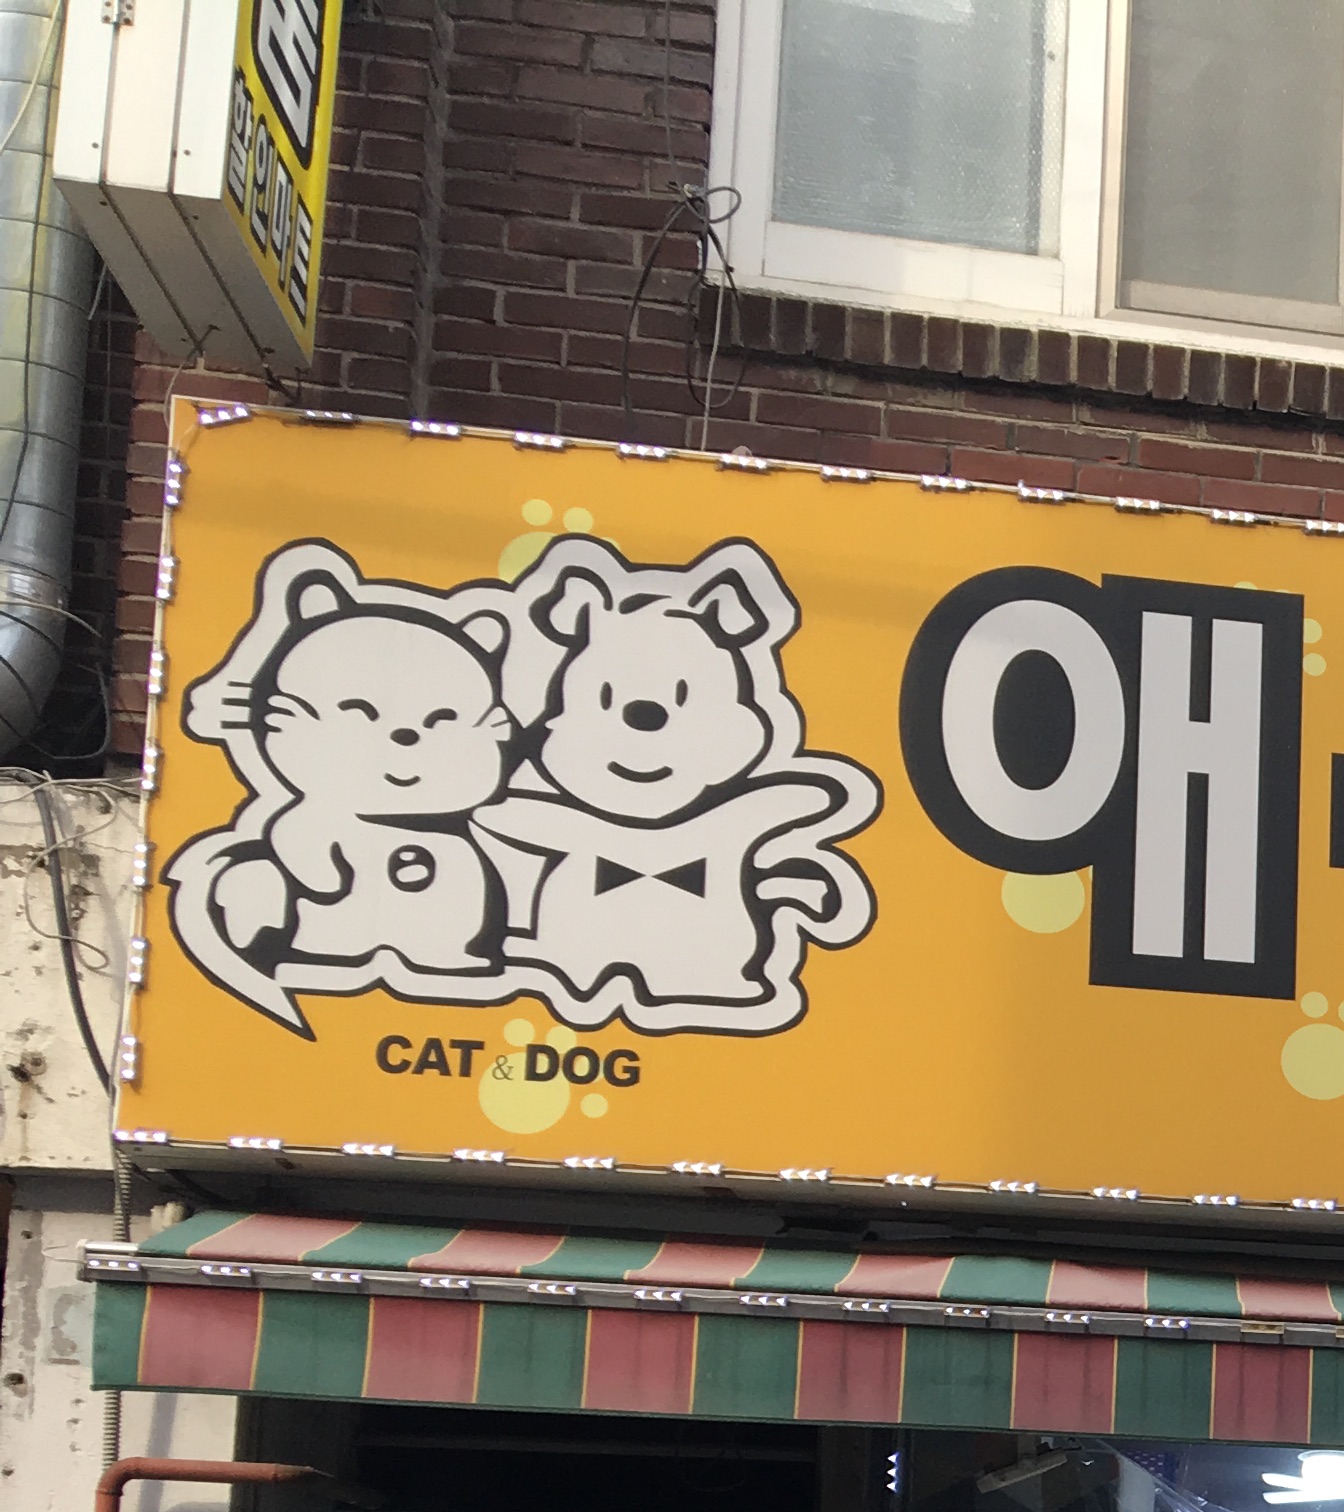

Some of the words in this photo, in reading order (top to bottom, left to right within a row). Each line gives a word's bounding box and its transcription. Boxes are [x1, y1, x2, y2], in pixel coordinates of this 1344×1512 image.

[226, 65, 313, 328] 할인마트
[376, 1034, 484, 1078] CAT
[491, 1055, 515, 1082] &
[524, 1042, 641, 1088] DOG
